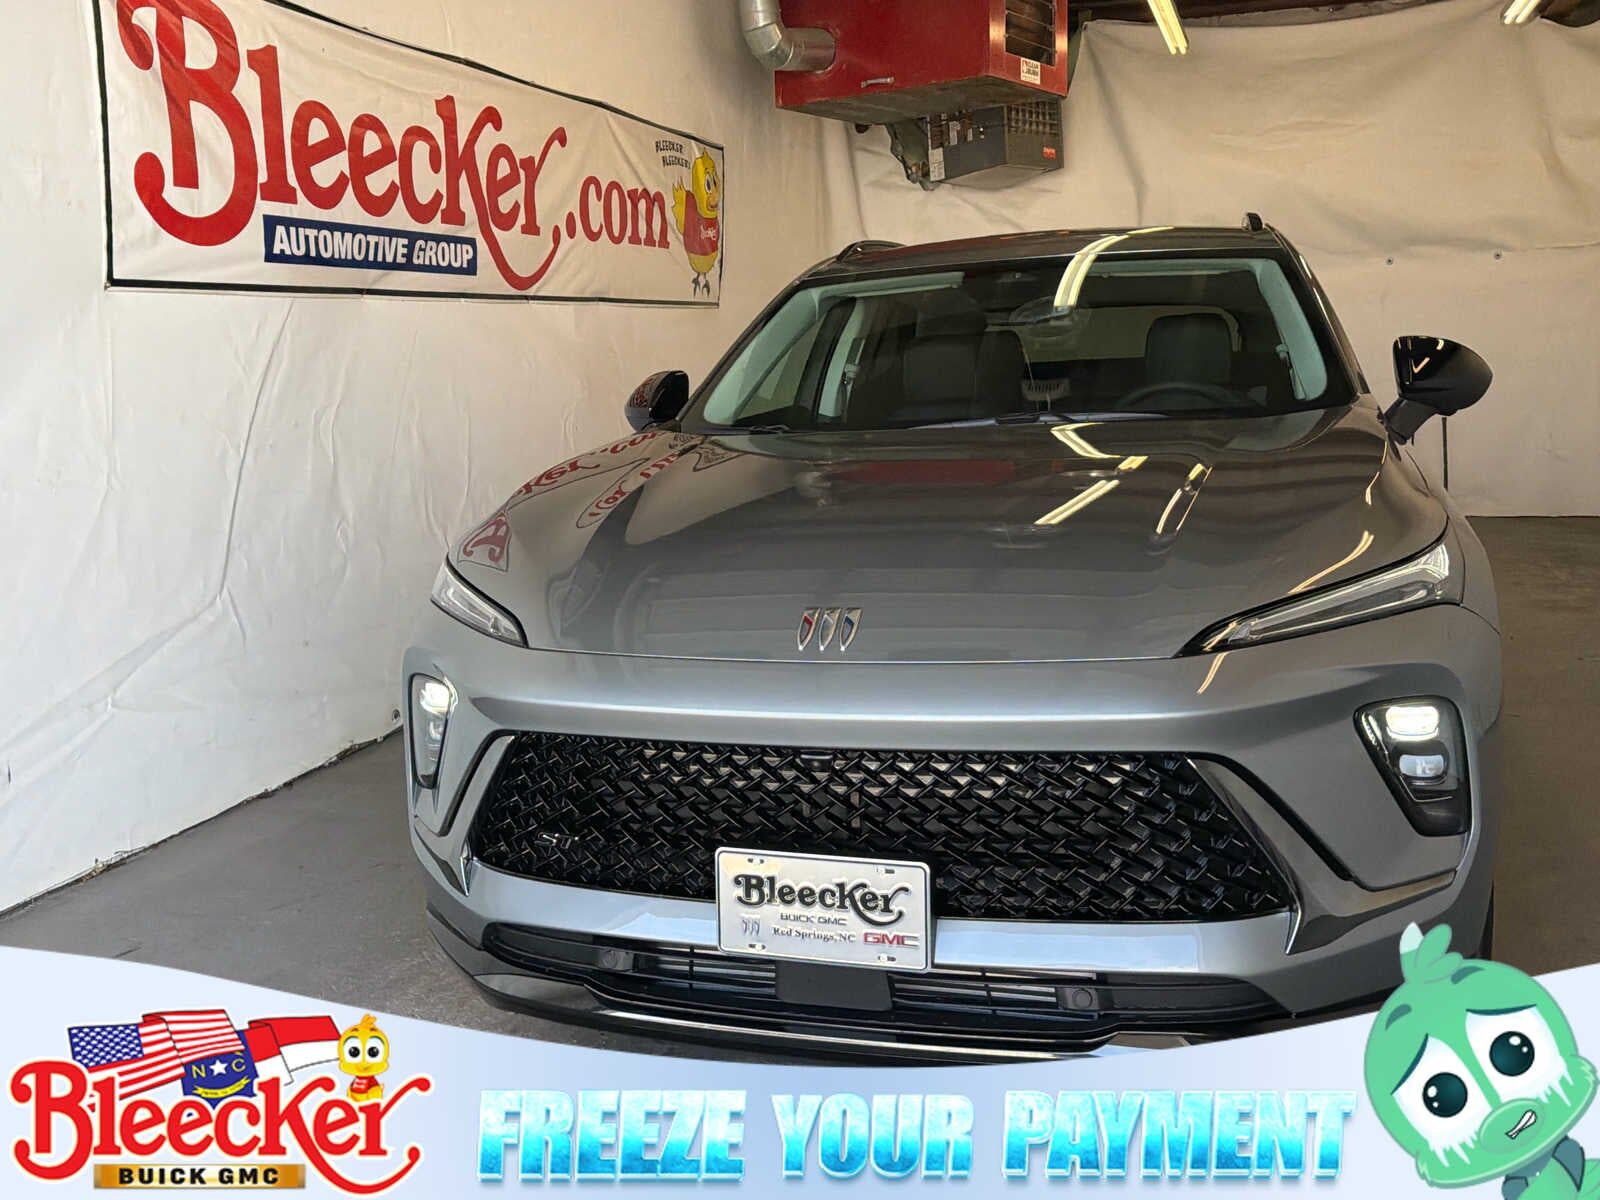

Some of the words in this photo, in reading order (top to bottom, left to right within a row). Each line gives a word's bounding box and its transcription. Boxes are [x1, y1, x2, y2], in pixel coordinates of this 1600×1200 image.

[272, 224, 409, 264] AUTOMOTIVE
[412, 239, 474, 269] GROUP
[733, 873, 912, 927] Bleecker
[780, 912, 815, 924] BUICK
[817, 915, 848, 926] GMC
[772, 926, 792, 937] Red
[863, 931, 919, 948] GMC
